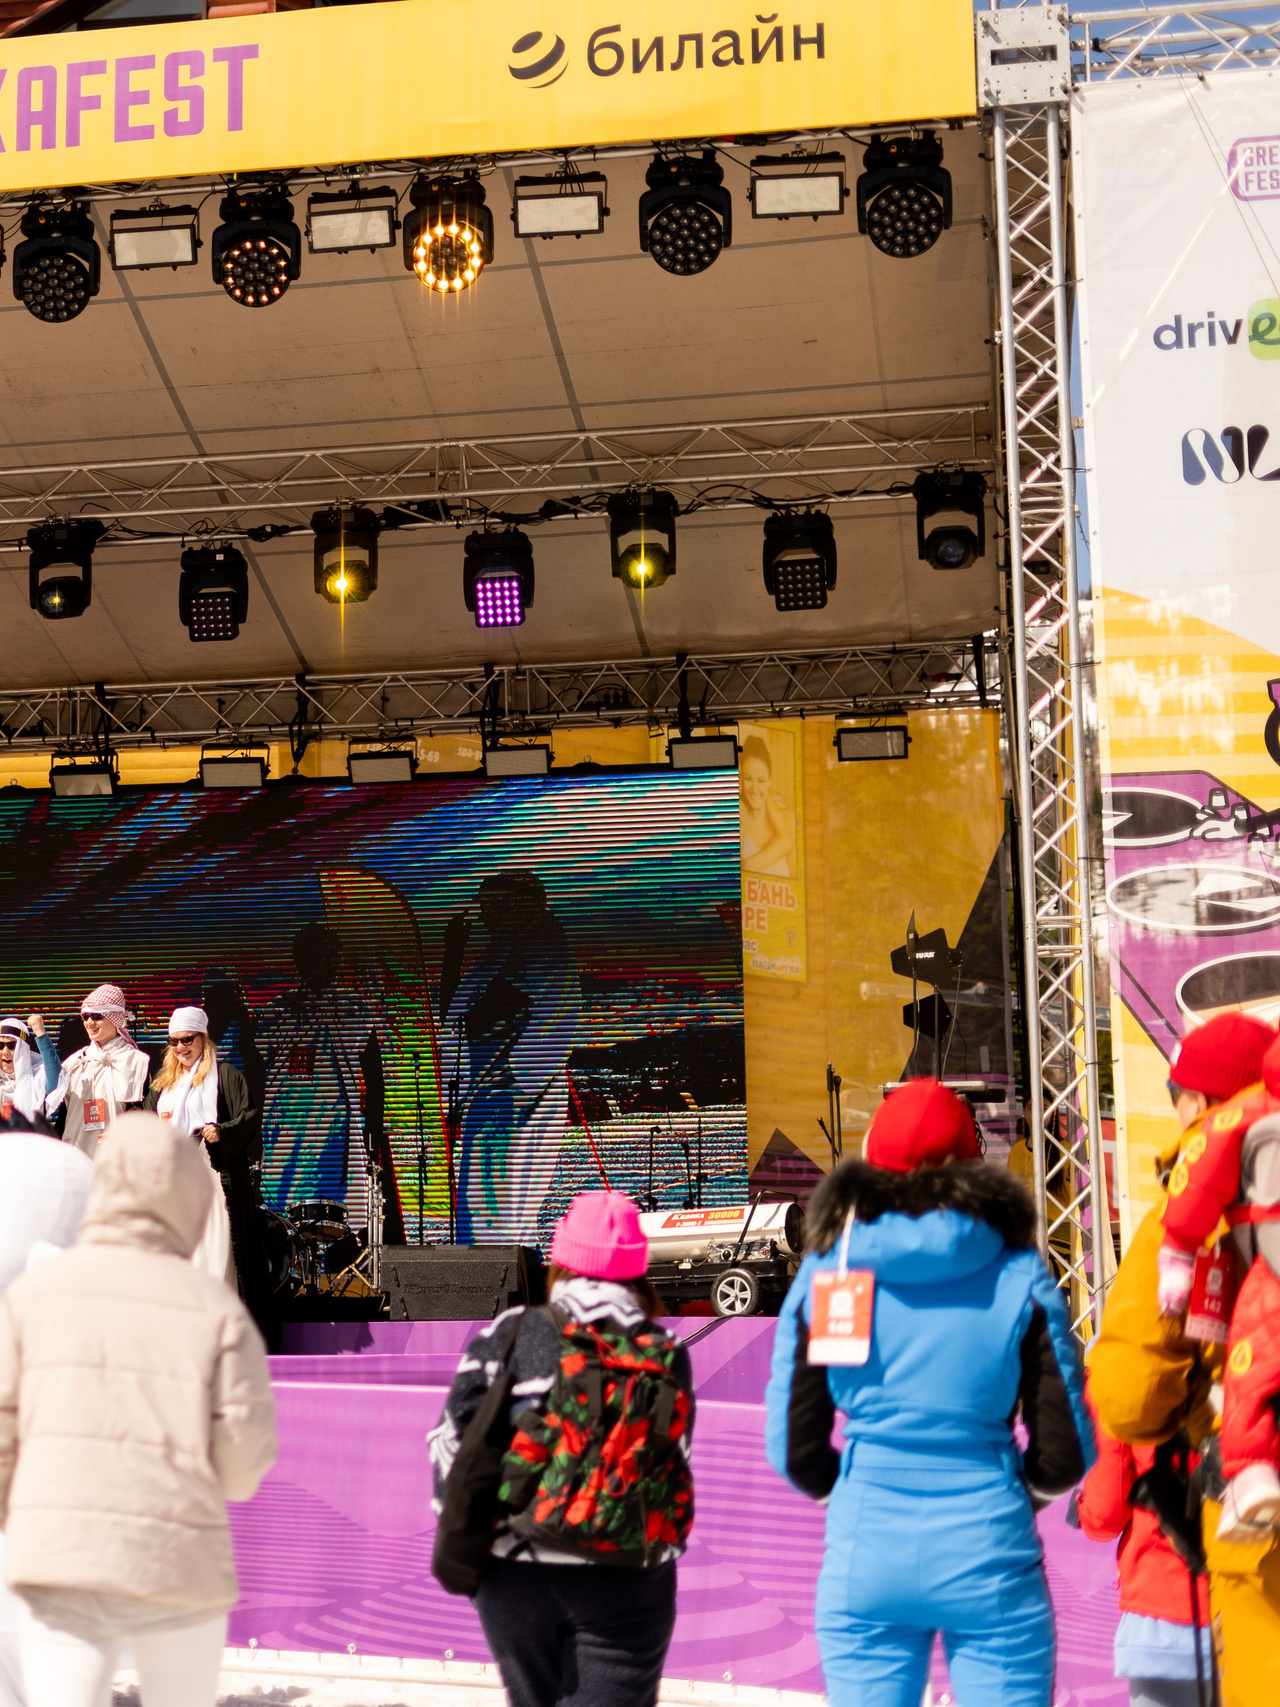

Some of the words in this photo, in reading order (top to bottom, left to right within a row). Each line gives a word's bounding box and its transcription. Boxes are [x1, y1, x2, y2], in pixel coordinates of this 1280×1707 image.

[587, 13, 826, 77] билайн
[1244, 169, 1280, 192] FES
[746, 879, 797, 910] БАНЬ
[708, 1210, 741, 1220] 30000
